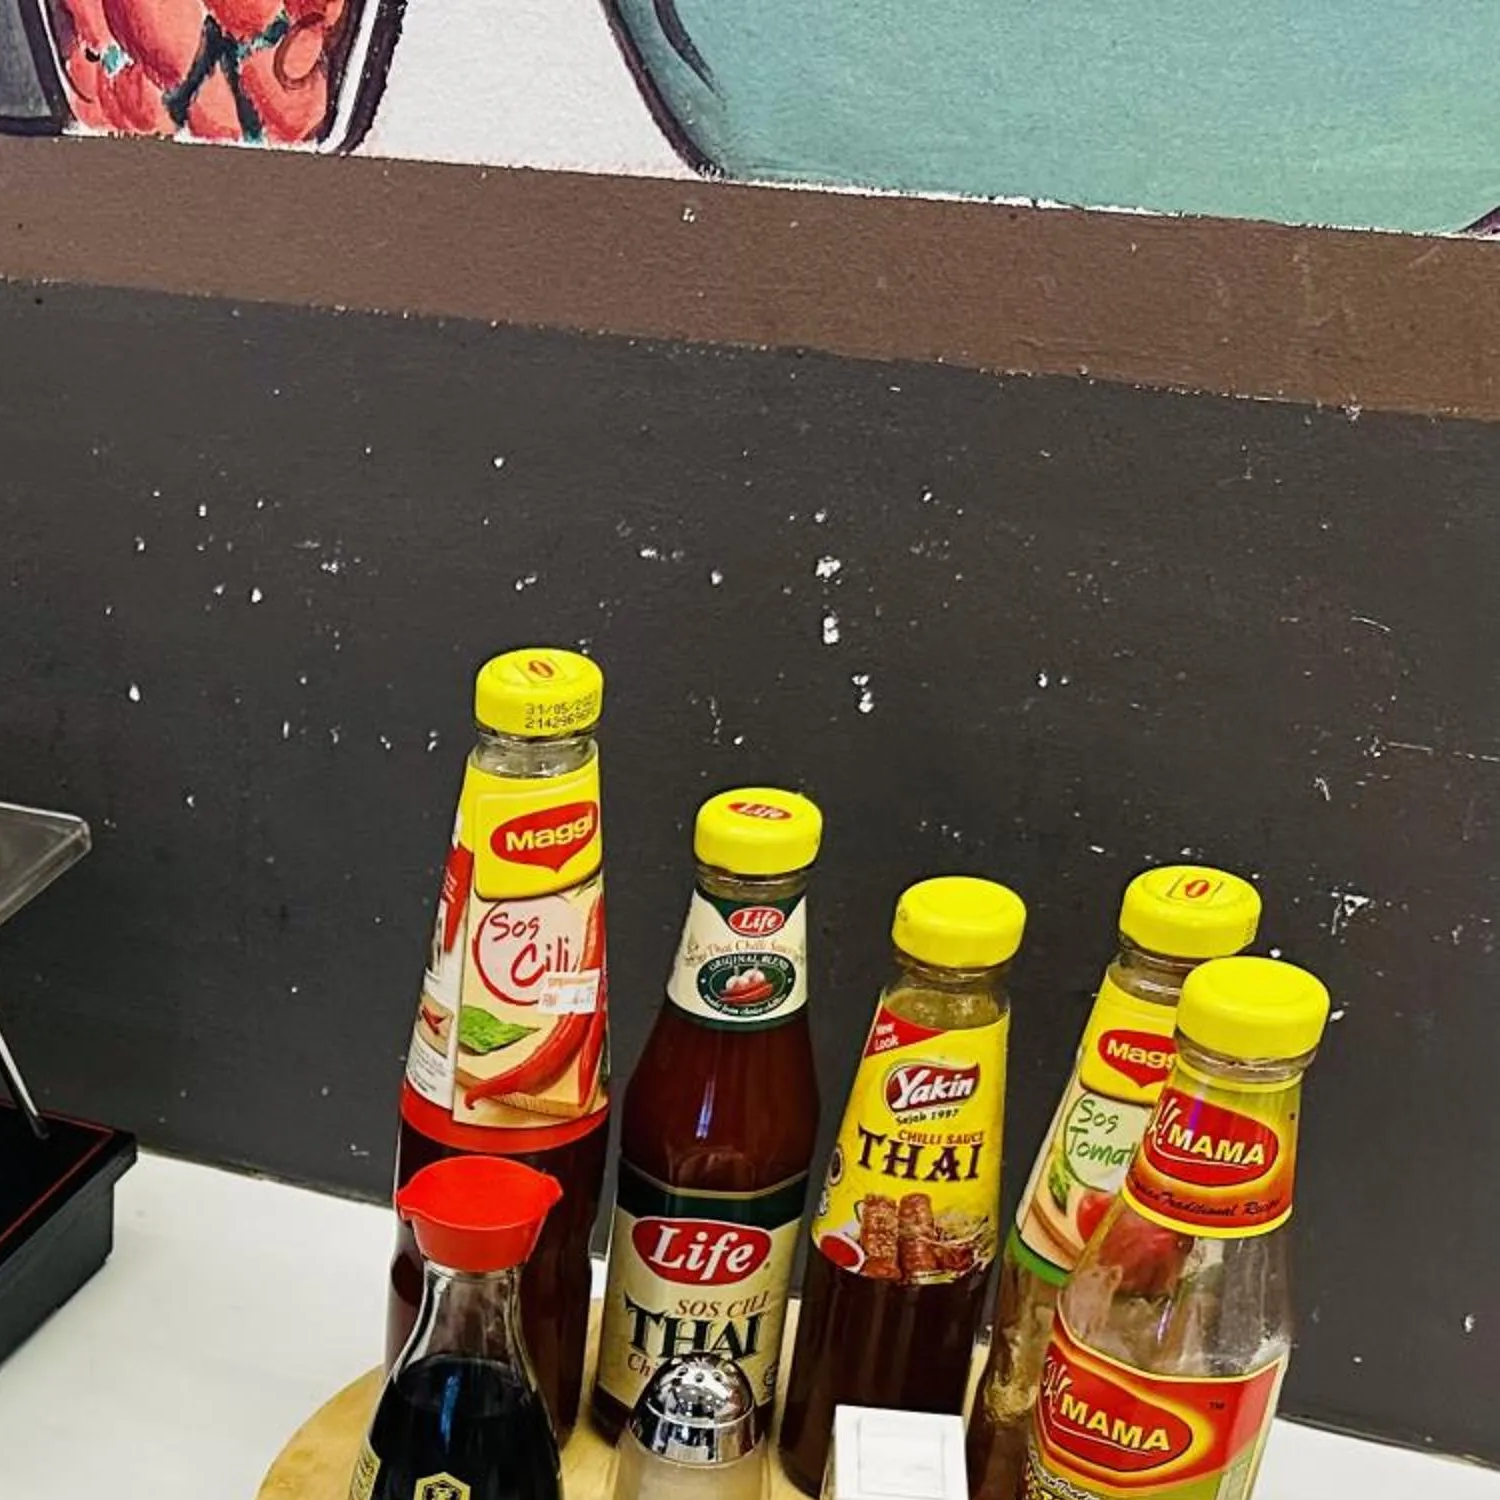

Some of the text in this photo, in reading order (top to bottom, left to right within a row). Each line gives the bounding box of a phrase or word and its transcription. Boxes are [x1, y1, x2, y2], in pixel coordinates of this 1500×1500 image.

[489, 911, 541, 942] Sos
[739, 910, 778, 932] Life
[509, 935, 570, 989] Cili
[708, 954, 758, 971] ORIGINAL
[890, 1067, 975, 1109] Yakin
[898, 1130, 985, 1145] CHILLI SAUCE
[1077, 1099, 1119, 1135] Sos
[857, 1121, 983, 1182] THAI
[1068, 1125, 1139, 1168] Tomat
[1167, 1123, 1266, 1165] MAMA
[649, 1224, 755, 1281] Life
[676, 1290, 770, 1319] SOS CILI
[623, 1291, 768, 1361] THAI
[1060, 1393, 1171, 1451] MAMA
